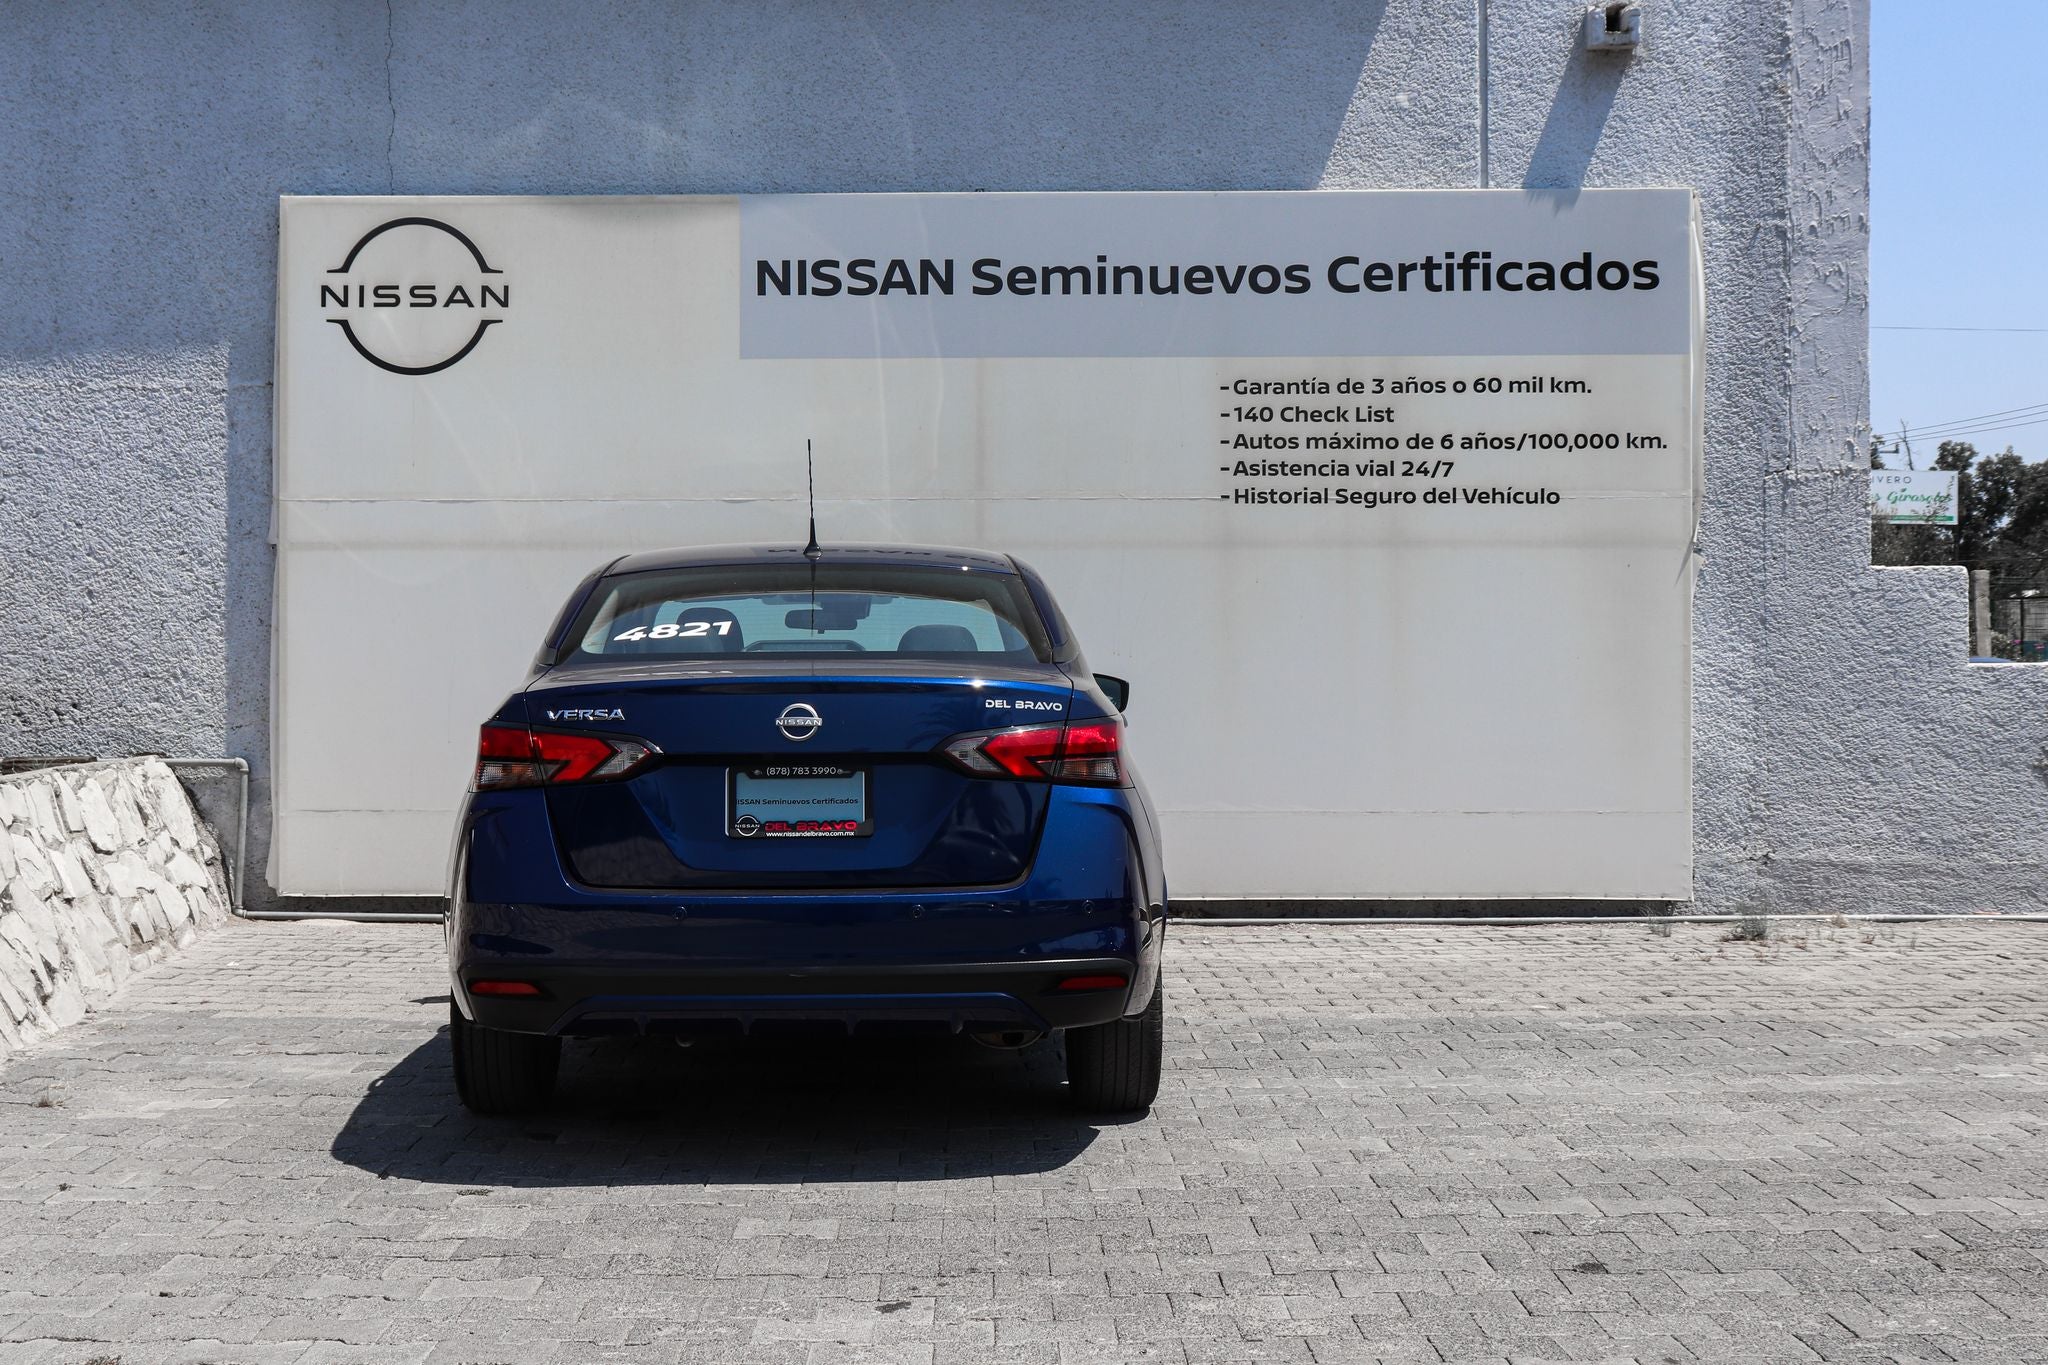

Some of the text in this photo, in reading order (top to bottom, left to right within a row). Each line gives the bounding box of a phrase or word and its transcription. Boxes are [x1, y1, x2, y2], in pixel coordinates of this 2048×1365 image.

[757, 250, 1660, 297] NISSAN Seminuevos Certificados
[320, 284, 509, 308] NISSAN
[1337, 377, 1365, 395] de
[1371, 378, 1385, 395] 3
[1390, 376, 1447, 394] años
[1452, 380, 1467, 394] o
[1472, 377, 1503, 394] 60
[1508, 376, 1544, 394] mil
[1550, 376, 1592, 394] km.
[1279, 405, 1350, 423] Check
[1355, 405, 1395, 423] List
[1305, 431, 1400, 450] máximo
[1405, 432, 1435, 450] de
[1440, 433, 1454, 450] 6
[1460, 432, 1620, 453] años/100,000
[1626, 432, 1668, 449] km.
[1355, 459, 1395, 477] vial
[1401, 460, 1455, 479] 24/7
[1871, 476, 1912, 484] IVERO
[1335, 488, 1417, 509] Seguro
[1422, 487, 1457, 505] del
[1461, 486, 1561, 505] Vehículo
[613, 620, 733, 641] 4821
[985, 699, 1063, 711] DEL BRAVO
[546, 708, 626, 721] VERSA
[766, 766, 837, 776] (878) 783 3990
[762, 797, 810, 805] Seminuevos
[812, 797, 859, 805] Certificados
[765, 821, 858, 832] DEL BRAVO
